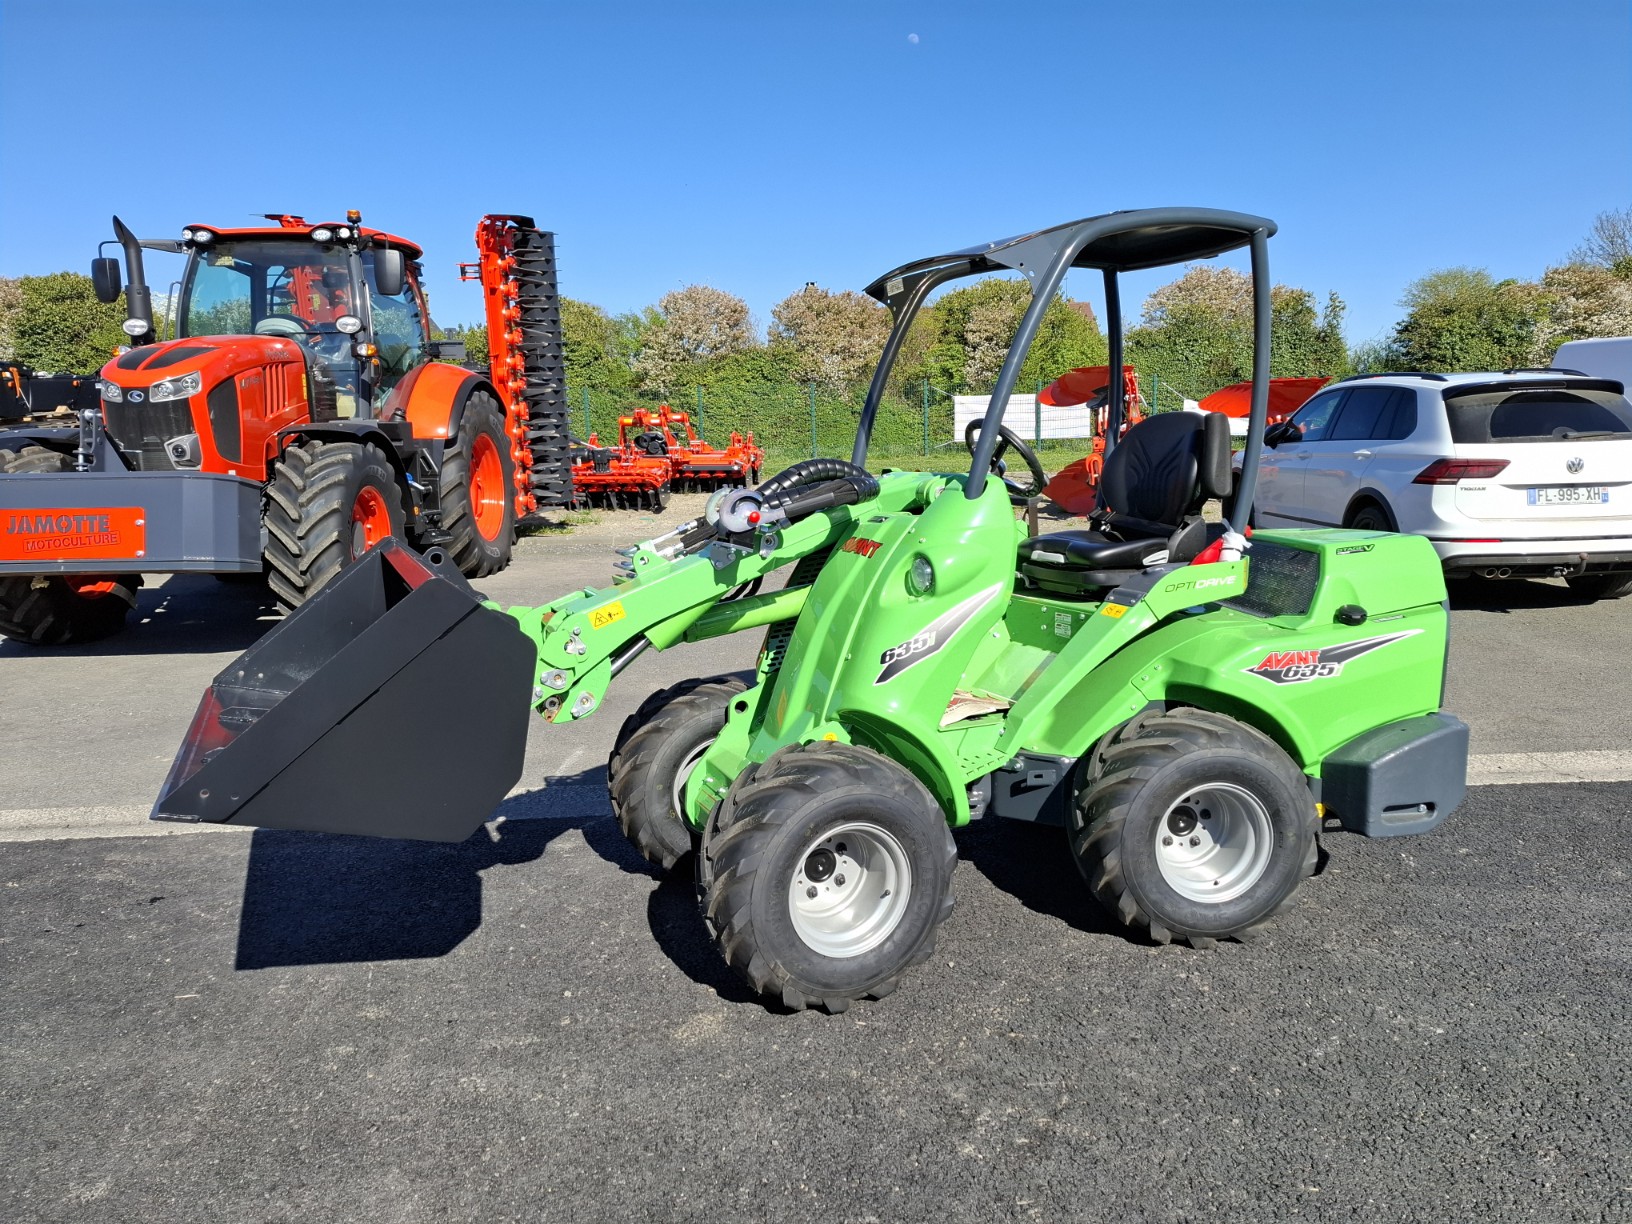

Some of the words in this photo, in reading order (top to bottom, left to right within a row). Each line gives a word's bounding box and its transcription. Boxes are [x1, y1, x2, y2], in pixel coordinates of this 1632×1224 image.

[1537, 487, 1601, 502] FL-995-XH
[6, 514, 111, 534] JAMOTTE
[25, 533, 118, 551] MOTOCULTURE
[1165, 576, 1236, 592] OPTIDRIVE
[1256, 650, 1321, 671] AVANT
